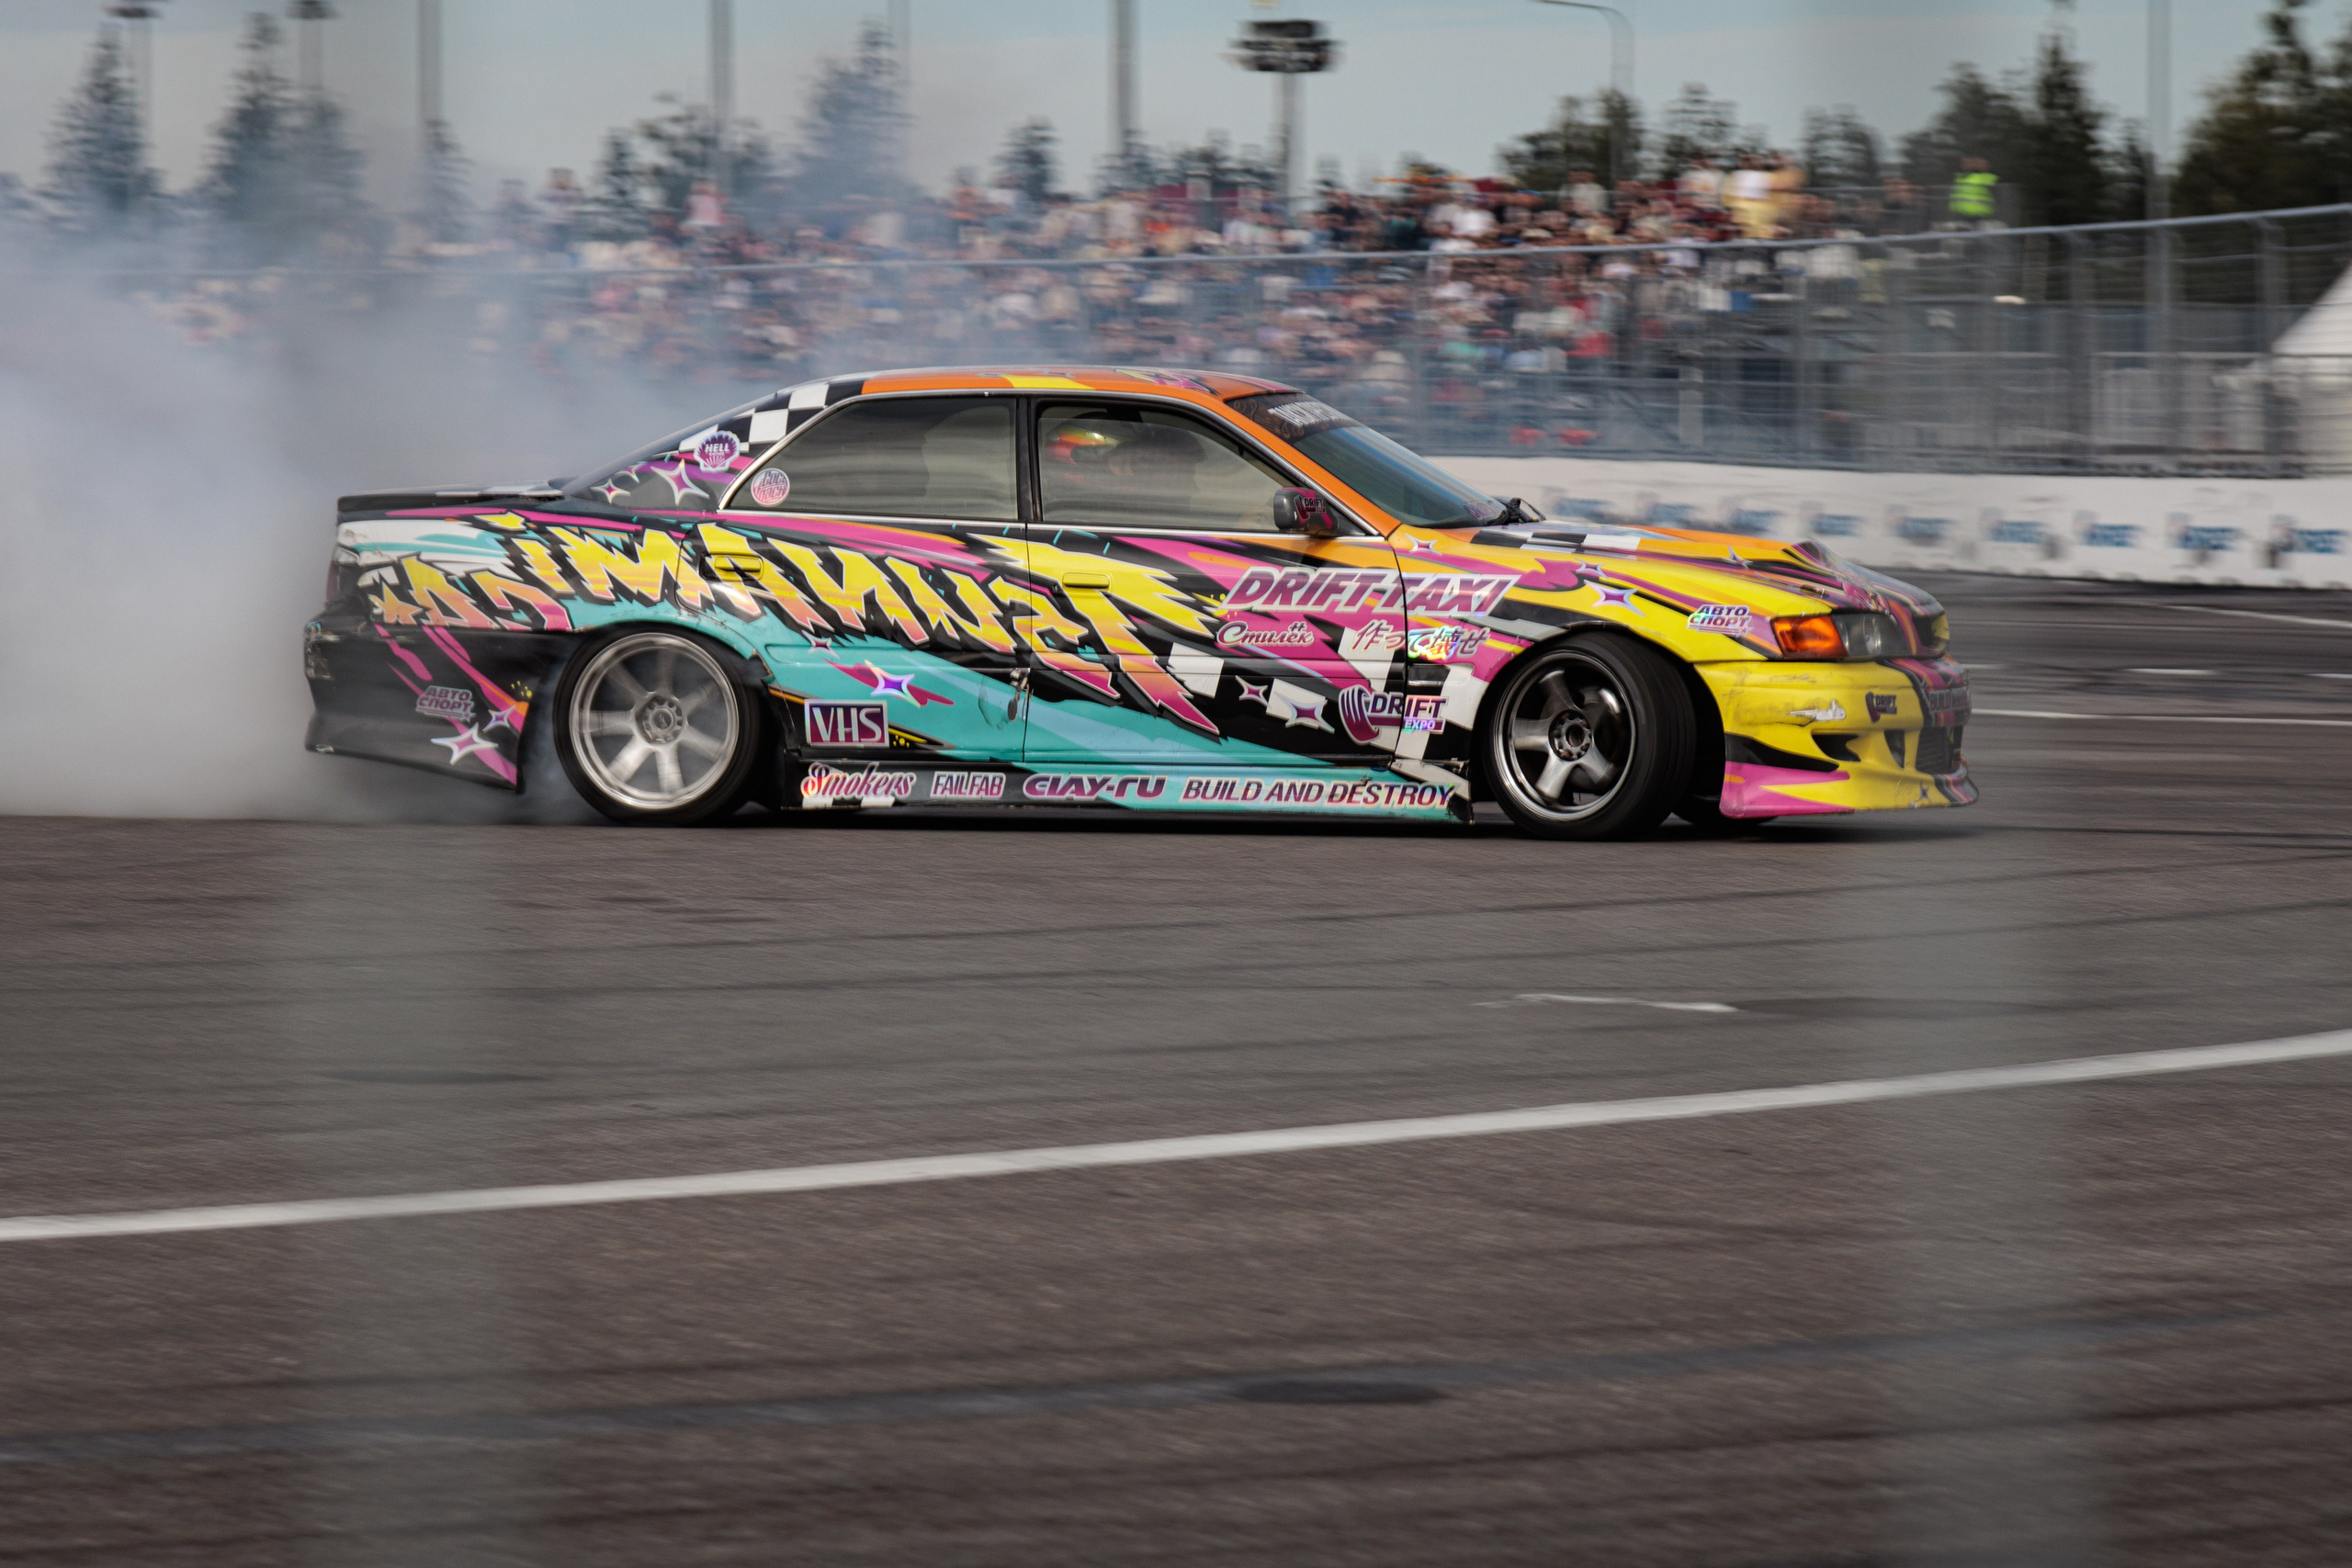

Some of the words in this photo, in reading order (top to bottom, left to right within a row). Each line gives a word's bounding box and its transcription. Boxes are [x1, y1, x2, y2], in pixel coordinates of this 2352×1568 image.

[705, 443, 730, 452] HELL
[1225, 570, 1388, 607] DRIFT
[1380, 575, 1511, 614] TAXI
[1698, 605, 1748, 616] АВТО
[1689, 615, 1750, 627] СПОРТ
[425, 687, 471, 701] АВТО
[418, 697, 472, 712] СПОРТ
[1370, 694, 1446, 718] DRIFT
[812, 706, 882, 742] VHS
[1404, 719, 1436, 730] EXPO
[801, 762, 915, 797] Smokers
[1182, 779, 1261, 802] BUILD
[1264, 780, 1325, 804] AND
[1327, 782, 1455, 807] DESTROY
